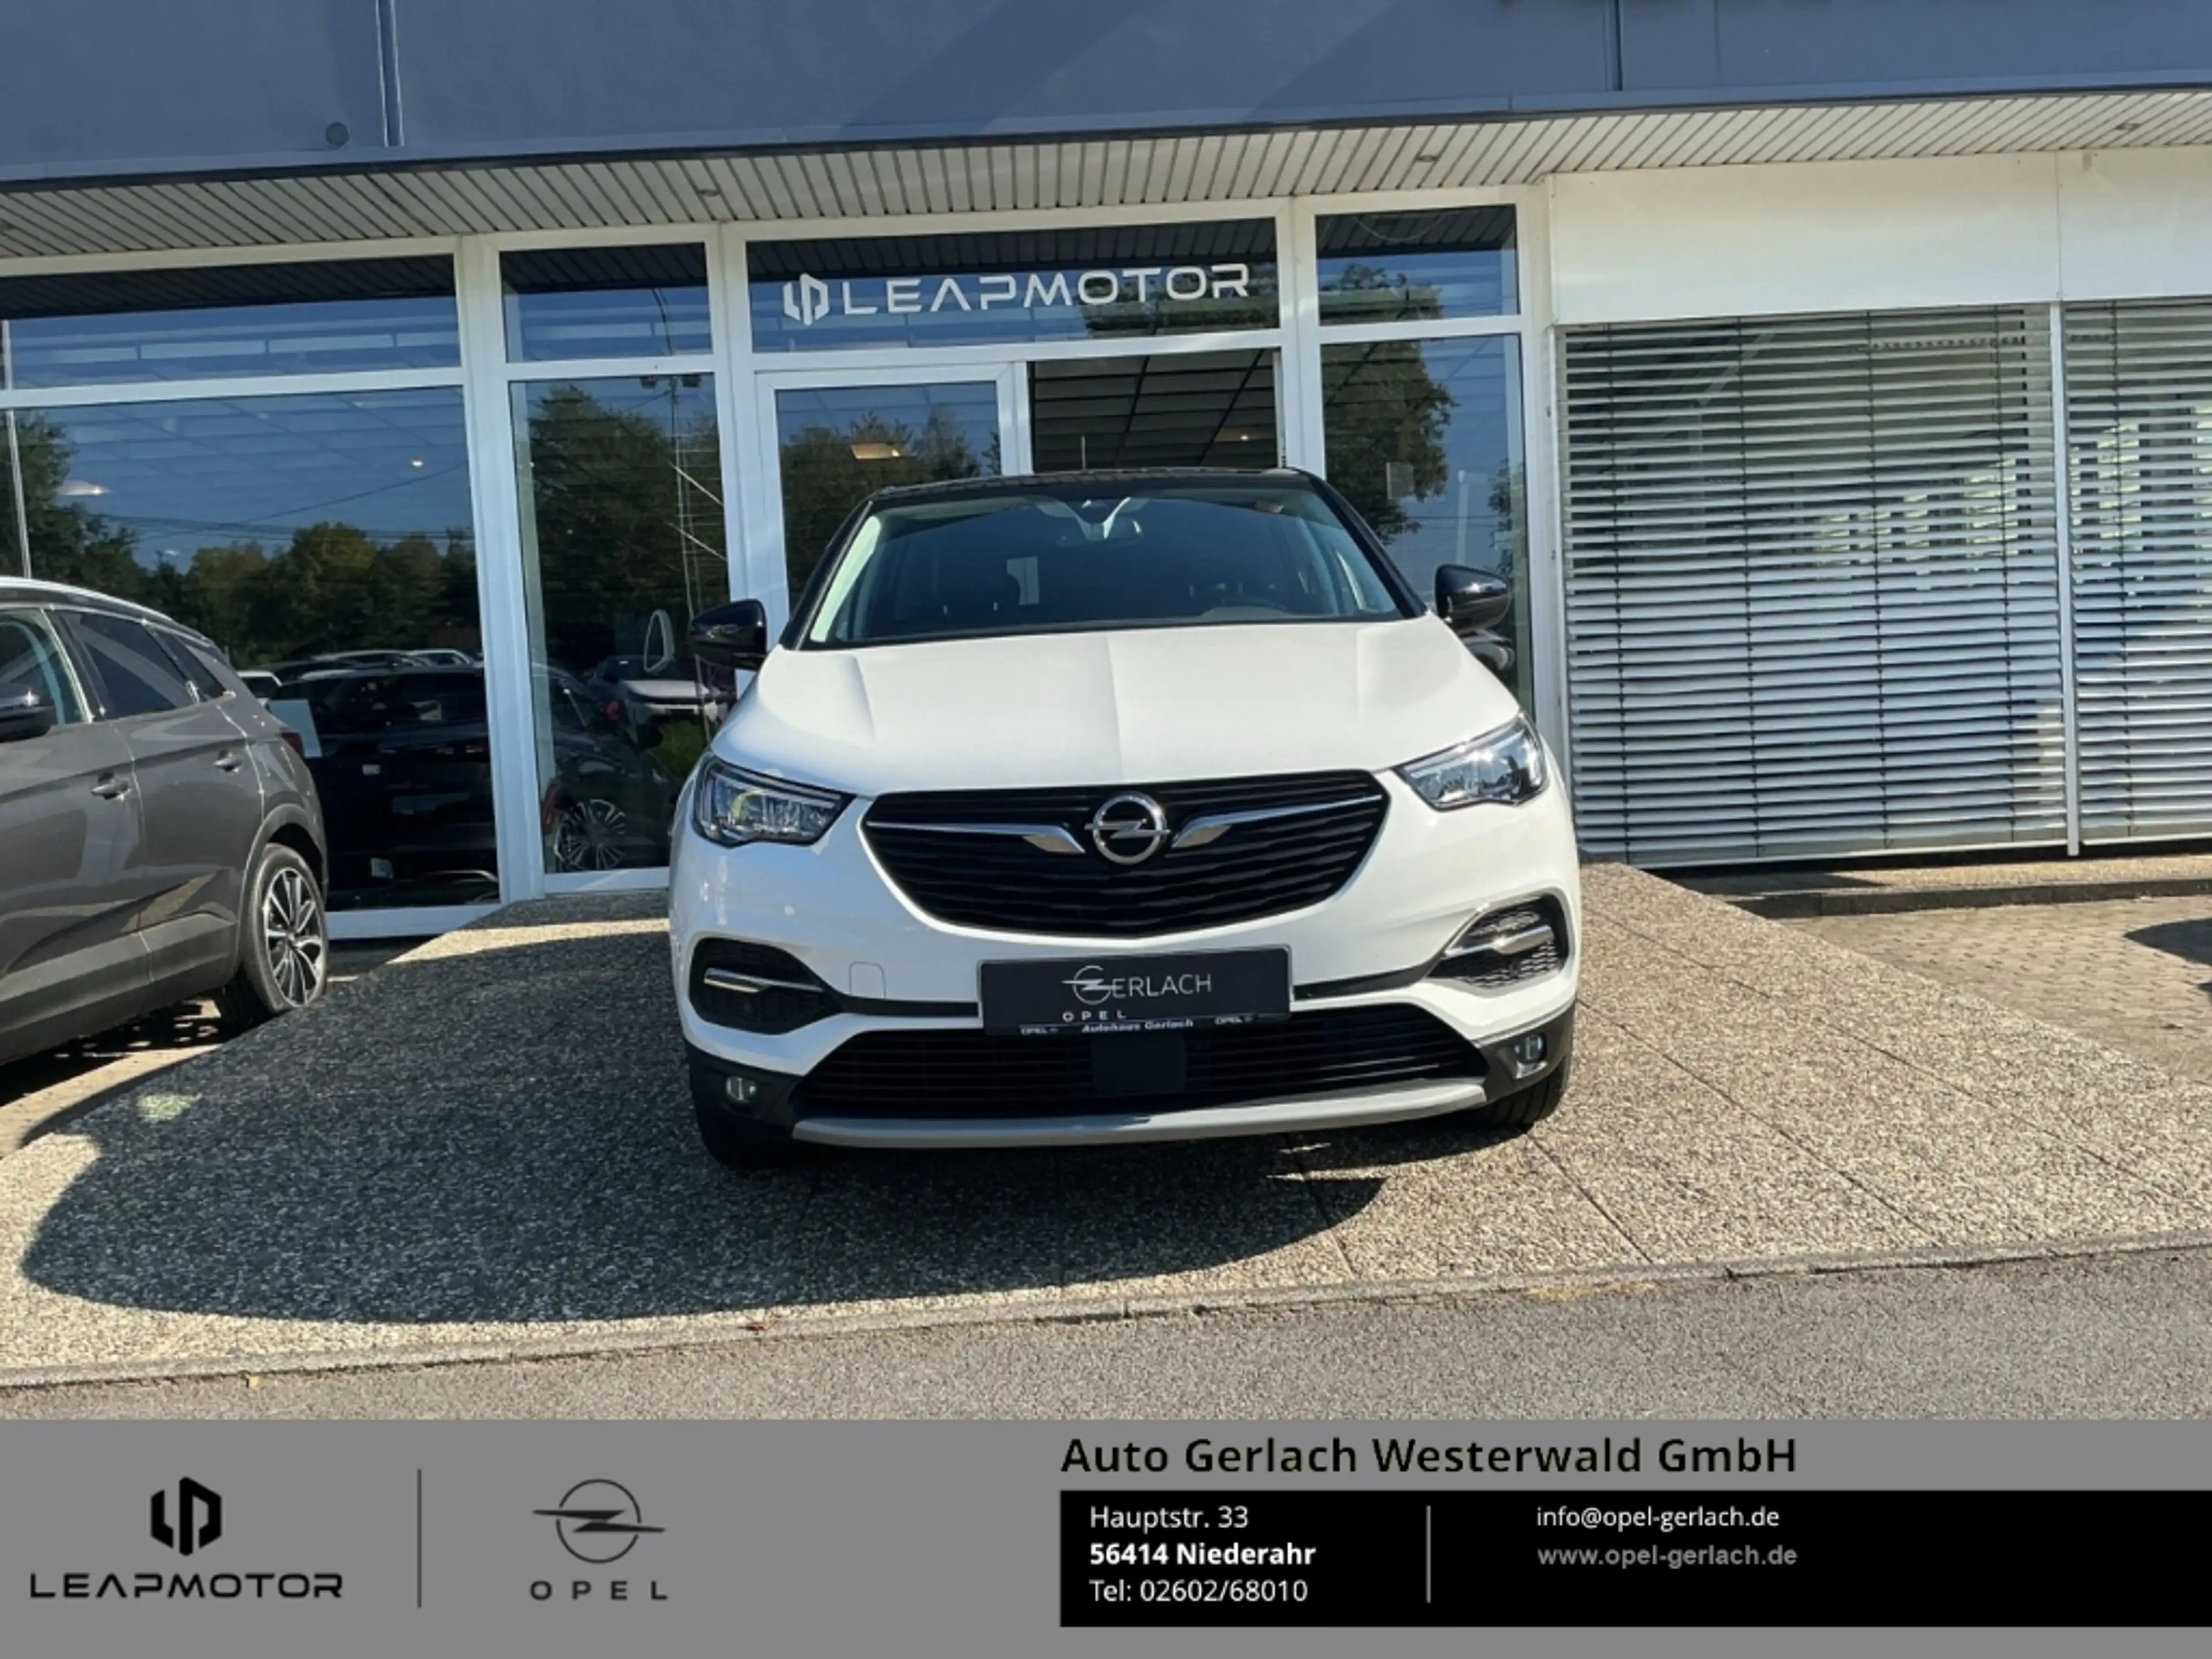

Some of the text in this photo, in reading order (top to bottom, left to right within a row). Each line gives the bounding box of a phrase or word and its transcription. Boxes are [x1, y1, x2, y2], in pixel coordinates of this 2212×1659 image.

[842, 263, 1250, 315] LEAPMOTOR
[1071, 965, 1212, 1005] GERLACH
[1062, 1009, 1127, 1022] OPEL
